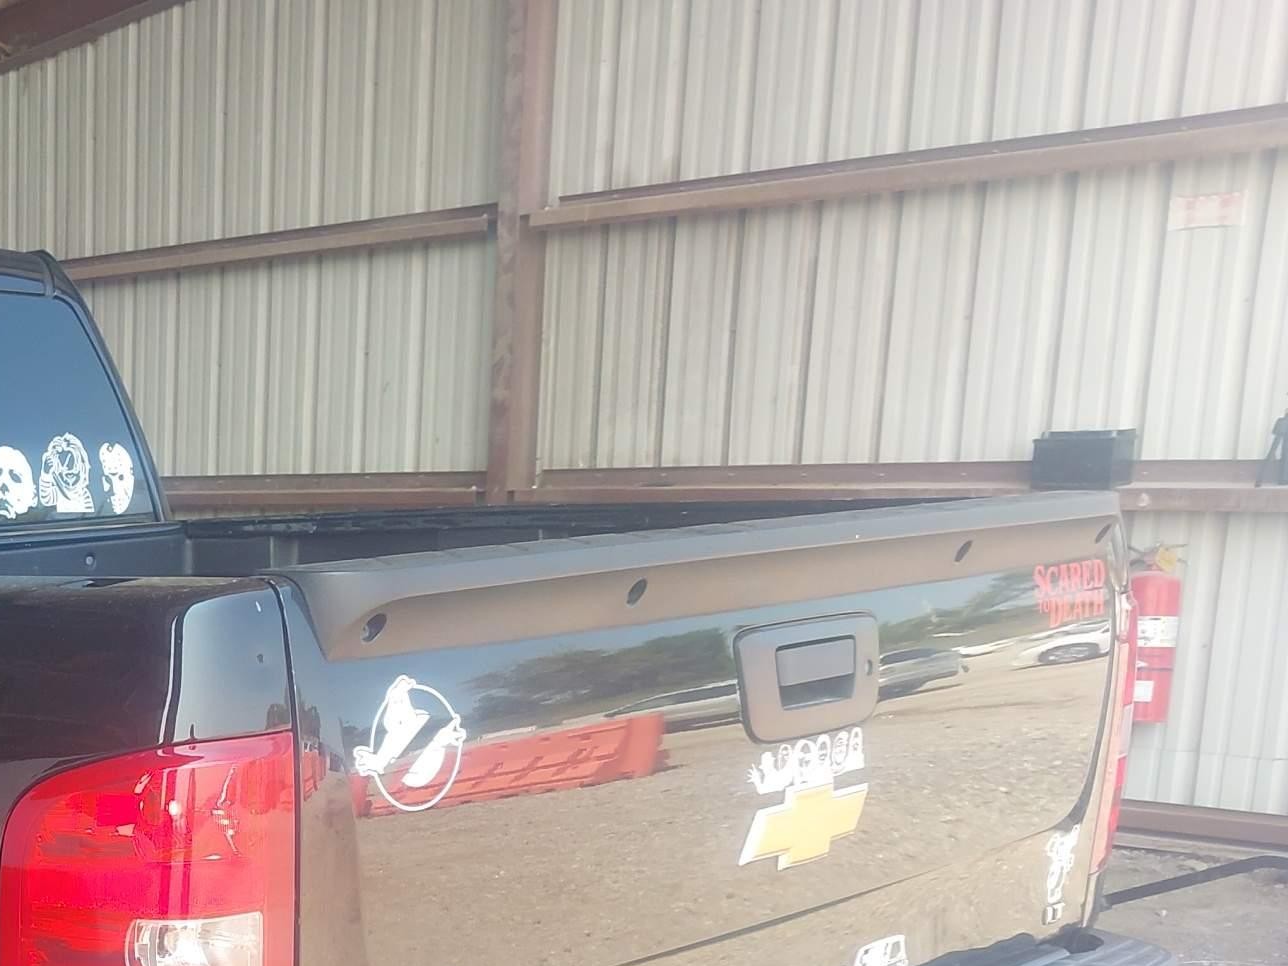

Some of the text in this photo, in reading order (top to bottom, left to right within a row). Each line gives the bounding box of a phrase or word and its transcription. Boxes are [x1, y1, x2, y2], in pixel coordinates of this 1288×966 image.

[1033, 559, 1106, 595] SCARED
[1049, 590, 1104, 628] DEATH
[1042, 902, 1065, 925] LT
